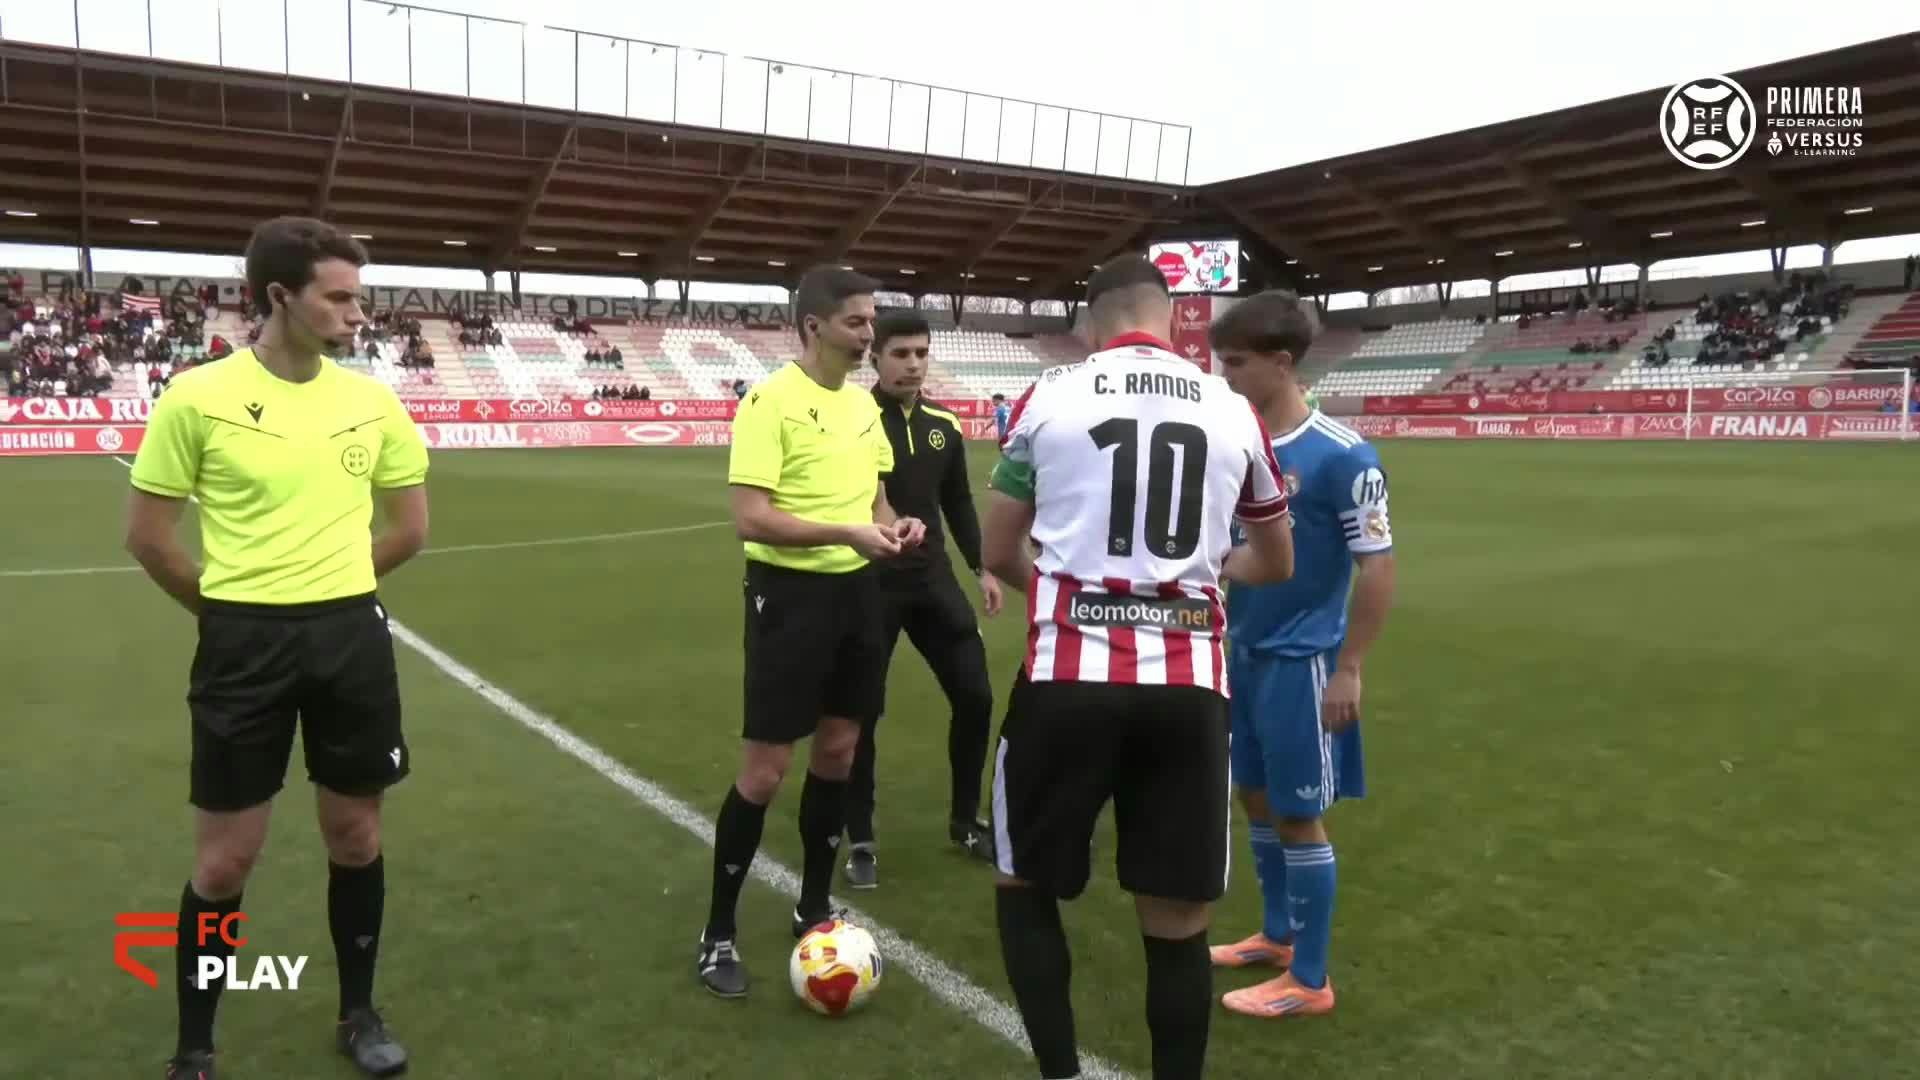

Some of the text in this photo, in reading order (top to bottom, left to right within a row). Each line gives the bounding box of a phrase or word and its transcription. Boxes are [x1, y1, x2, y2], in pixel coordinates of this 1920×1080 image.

[1094, 372, 1201, 403] C. RAMOS
[22, 397, 103, 421] CAJA
[428, 401, 460, 413] salud
[438, 424, 527, 447] RURAL
[1710, 415, 1808, 437] FRANJA
[0, 431, 75, 449] DERACIÓN
[1087, 417, 1208, 560] 10
[1070, 596, 1210, 627] leomotor.net
